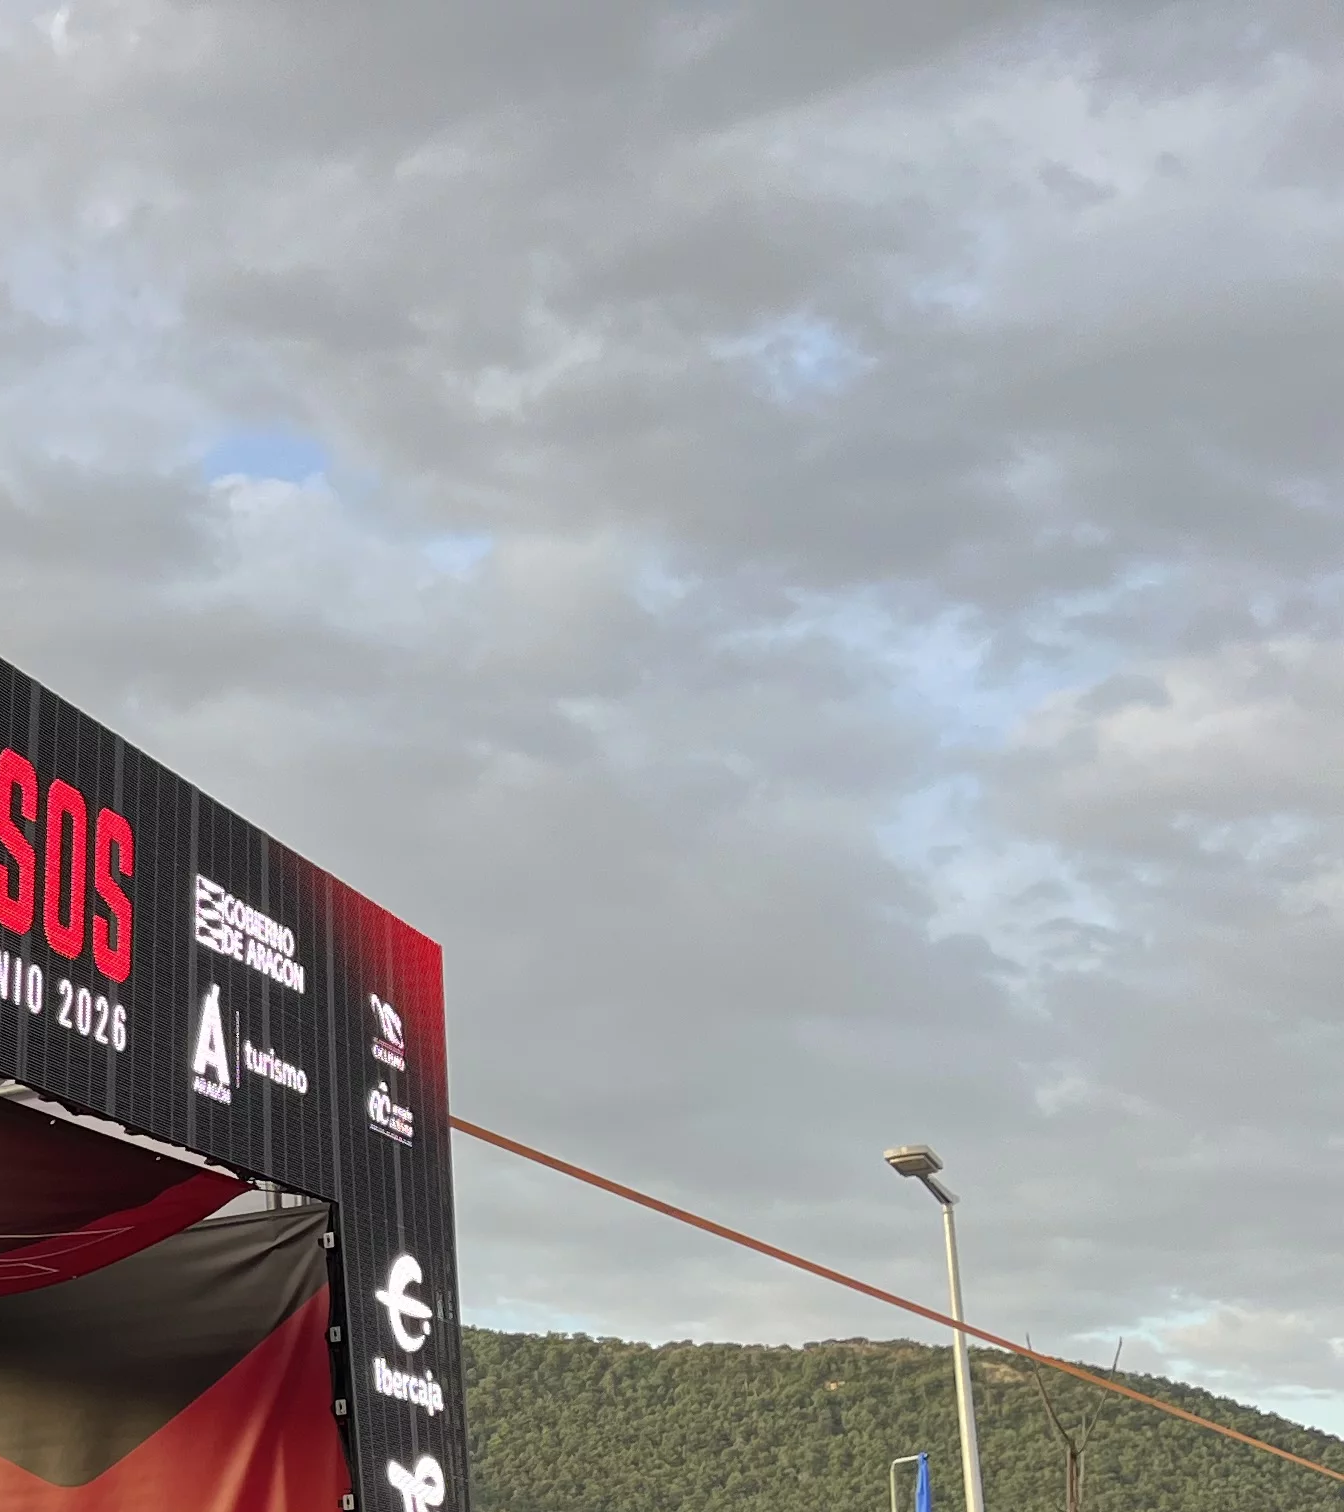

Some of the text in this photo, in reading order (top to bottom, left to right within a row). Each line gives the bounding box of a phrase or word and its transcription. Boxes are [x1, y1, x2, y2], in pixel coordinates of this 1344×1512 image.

[221, 925, 243, 961] DE
[222, 894, 295, 957] GOBIERNO
[59, 978, 128, 1053] 2026
[242, 1039, 309, 1095] turismo
[373, 1356, 444, 1417] Ibercaja
